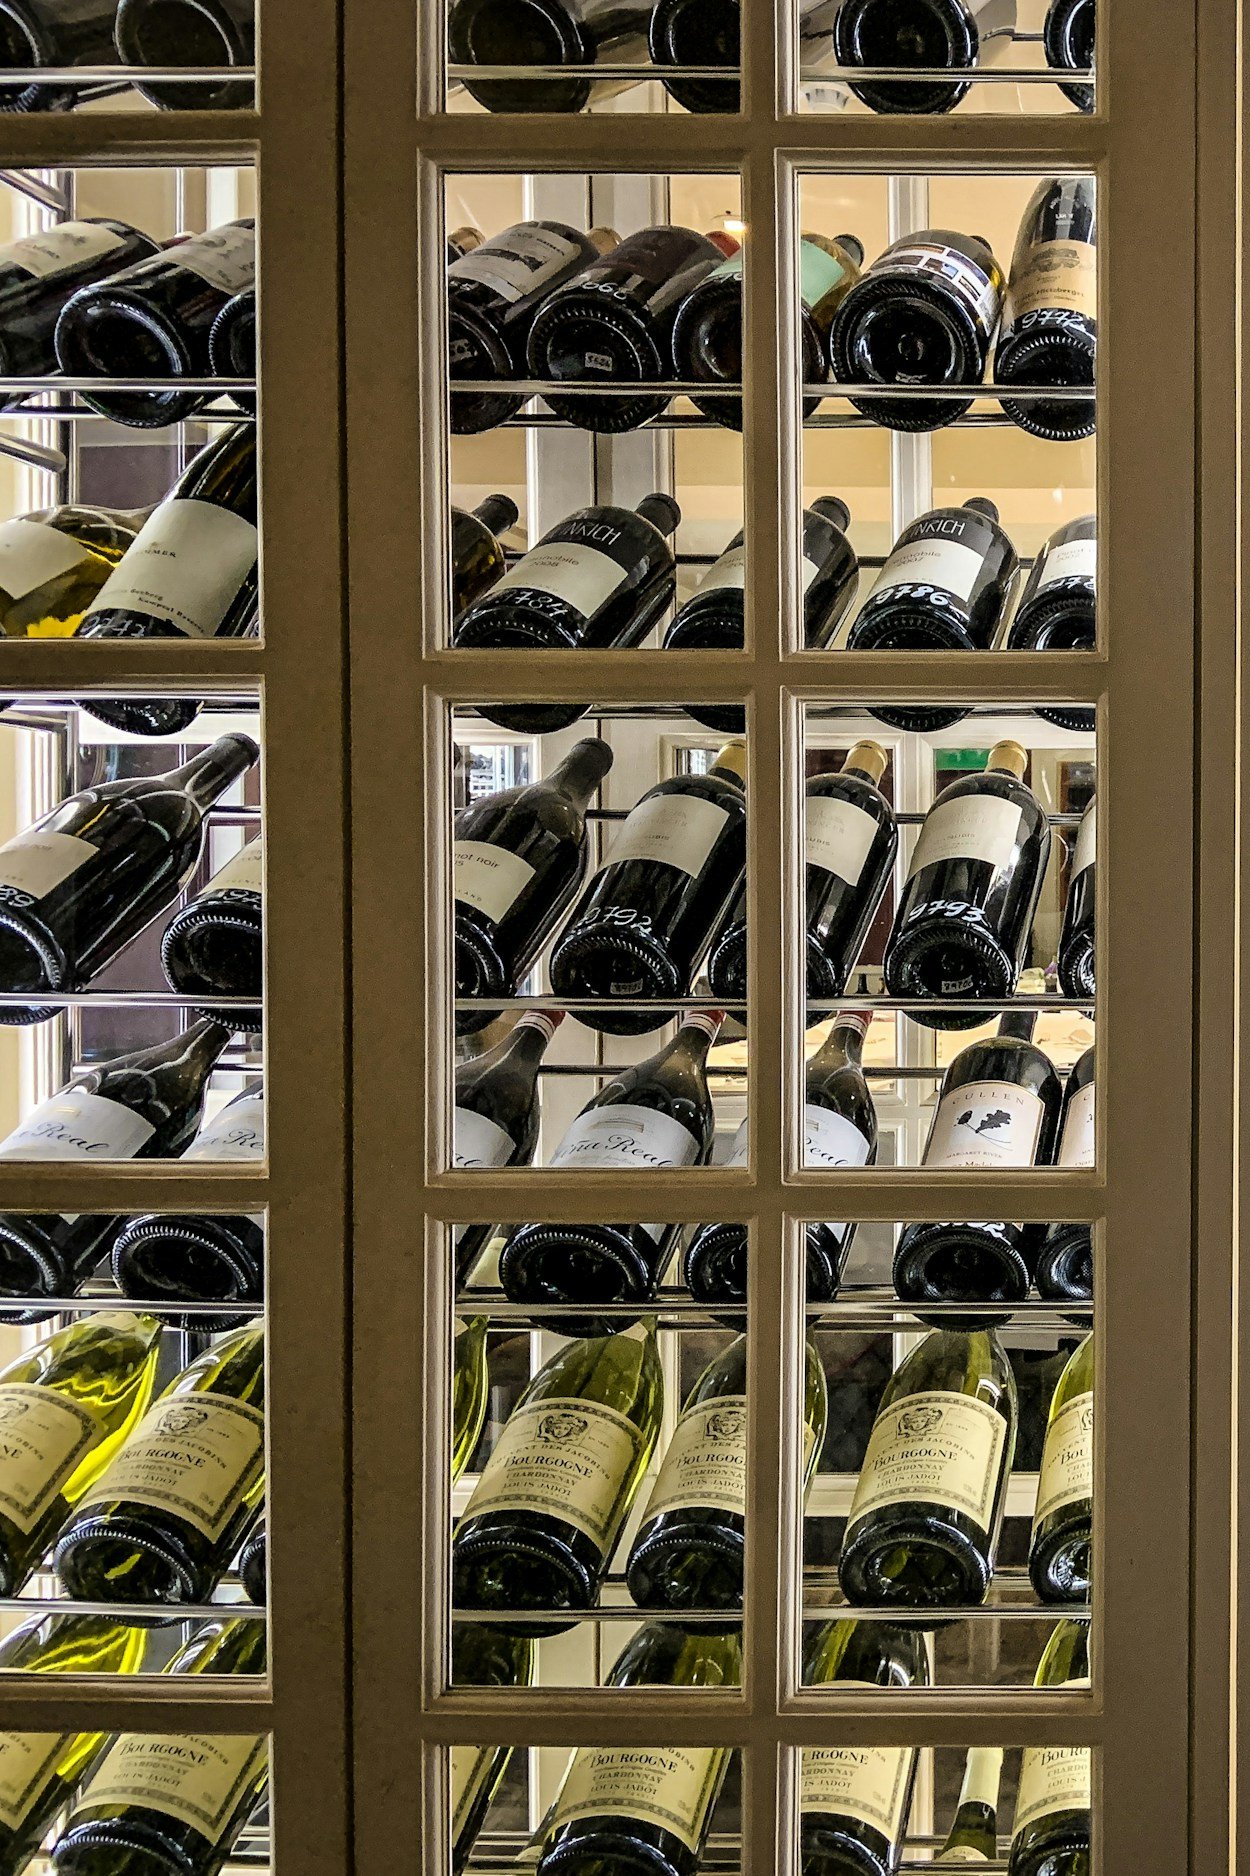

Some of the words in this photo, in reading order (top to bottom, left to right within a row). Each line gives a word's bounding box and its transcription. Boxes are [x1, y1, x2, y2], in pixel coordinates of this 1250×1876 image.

[875, 586, 952, 606] 9786
[908, 900, 985, 922] 9793
[34, 1121, 111, 1153] Real
[503, 1455, 594, 1479] BOURGOGNE
[873, 1448, 958, 1471] BOURGOGNE
[589, 1752, 679, 1774] BOURGOGNE
